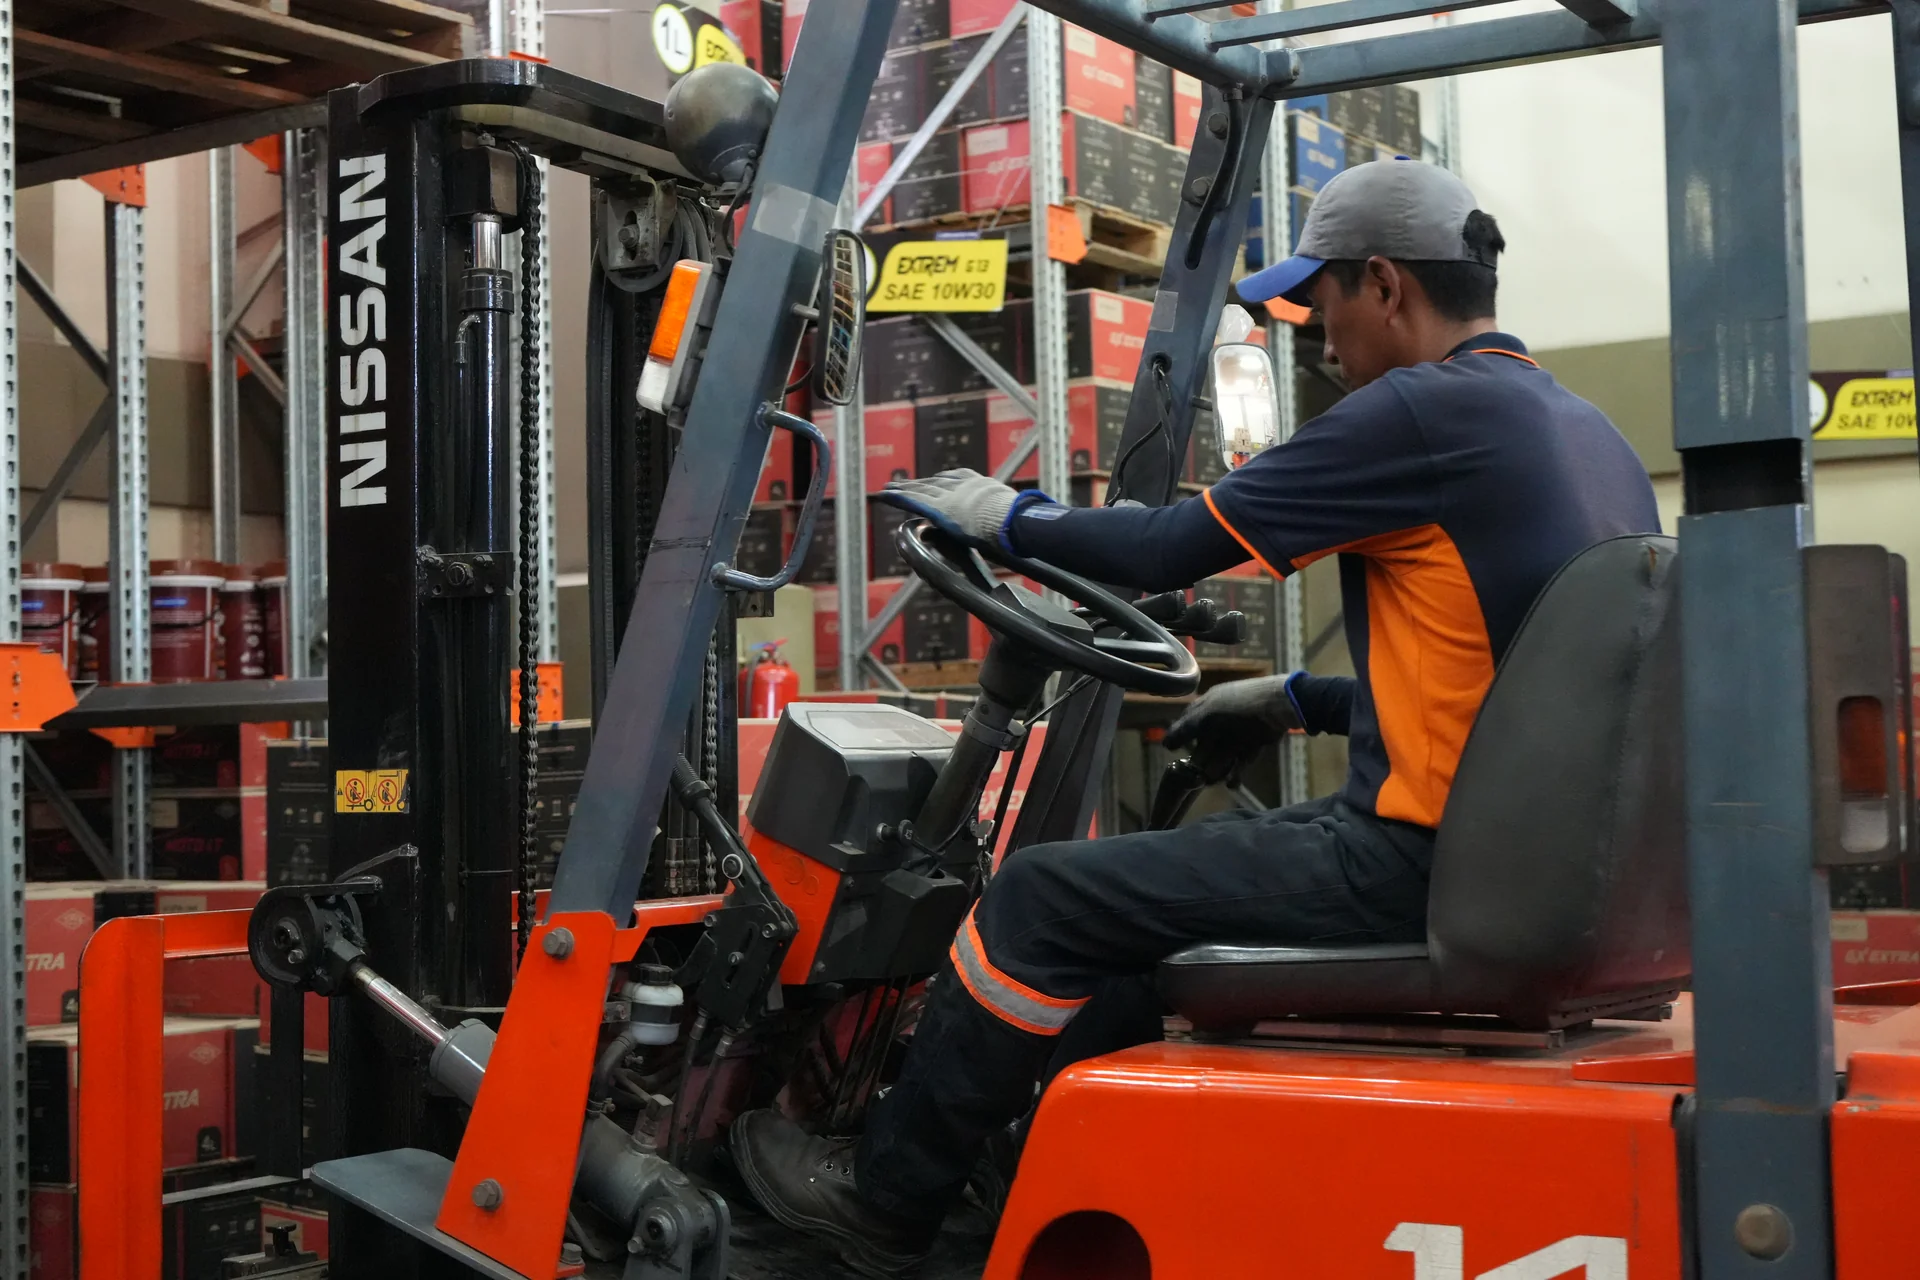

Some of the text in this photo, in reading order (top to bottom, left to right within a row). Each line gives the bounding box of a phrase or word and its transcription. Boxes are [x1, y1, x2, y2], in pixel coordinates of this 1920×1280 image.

[897, 255, 960, 277] EXTREM
[884, 282, 996, 301] SAE 10W30
[339, 154, 387, 507] NISSAN
[1850, 389, 1913, 408] EXTREM
[1837, 412, 1878, 430] SAE
